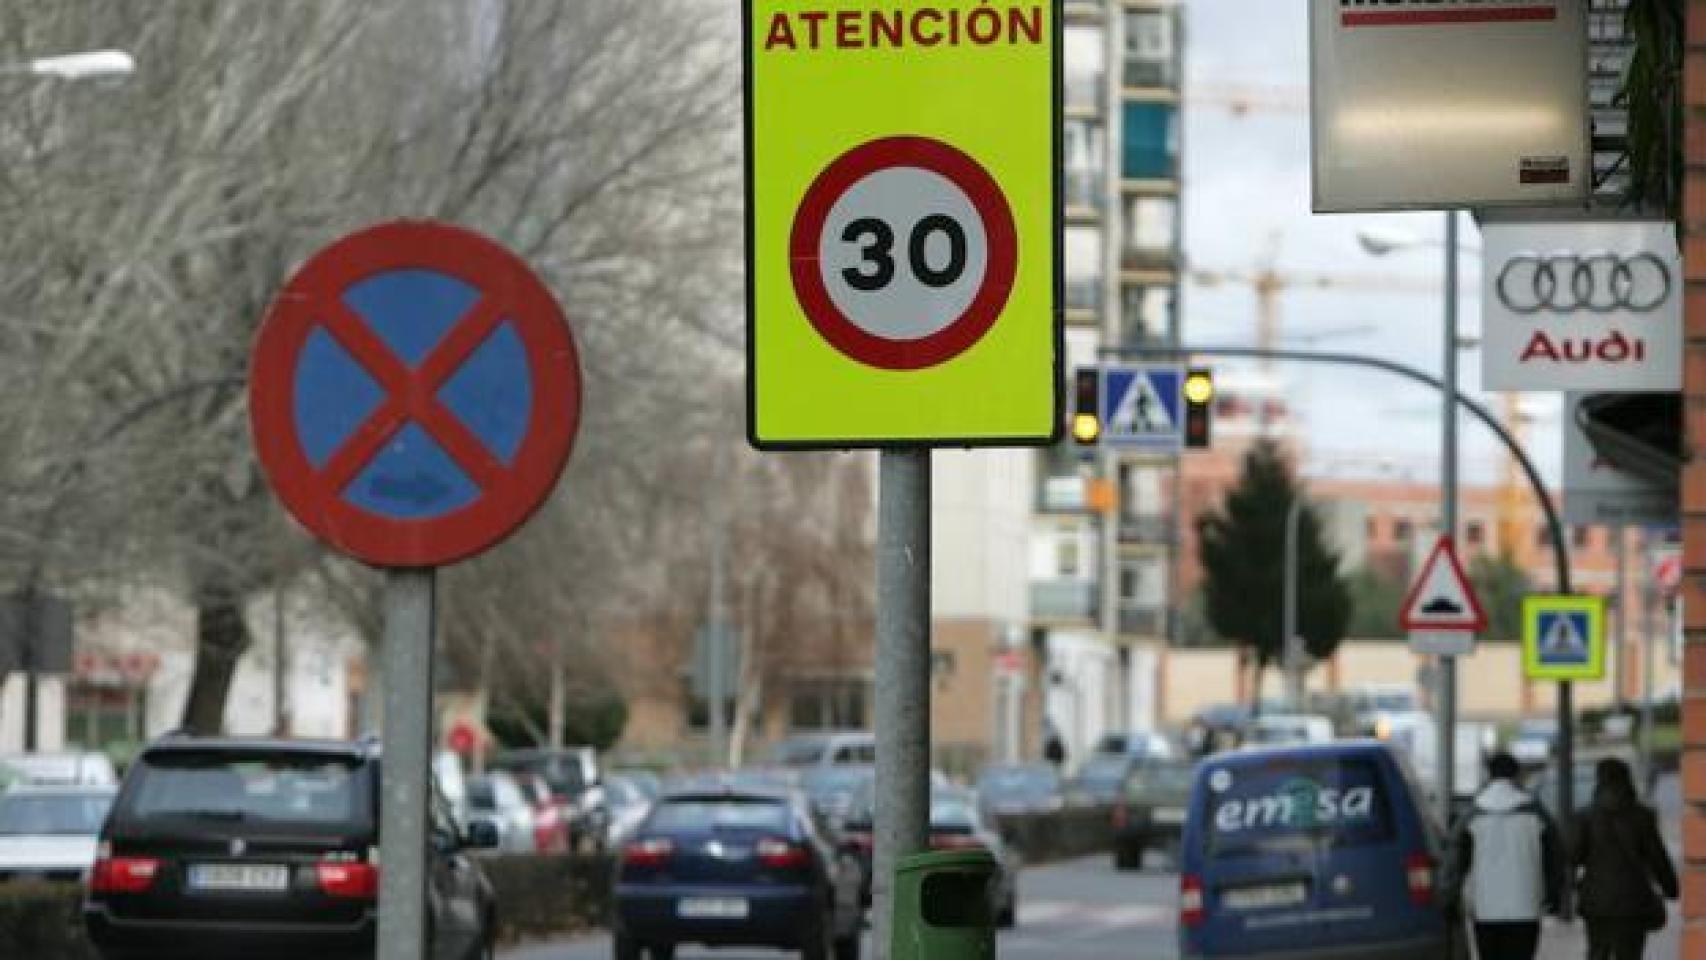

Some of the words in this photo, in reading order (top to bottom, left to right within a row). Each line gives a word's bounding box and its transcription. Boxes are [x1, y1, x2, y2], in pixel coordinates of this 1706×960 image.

[764, 1, 1043, 49] ATENCIÓN
[841, 213, 968, 291] 30
[1519, 329, 1645, 362] Audi
